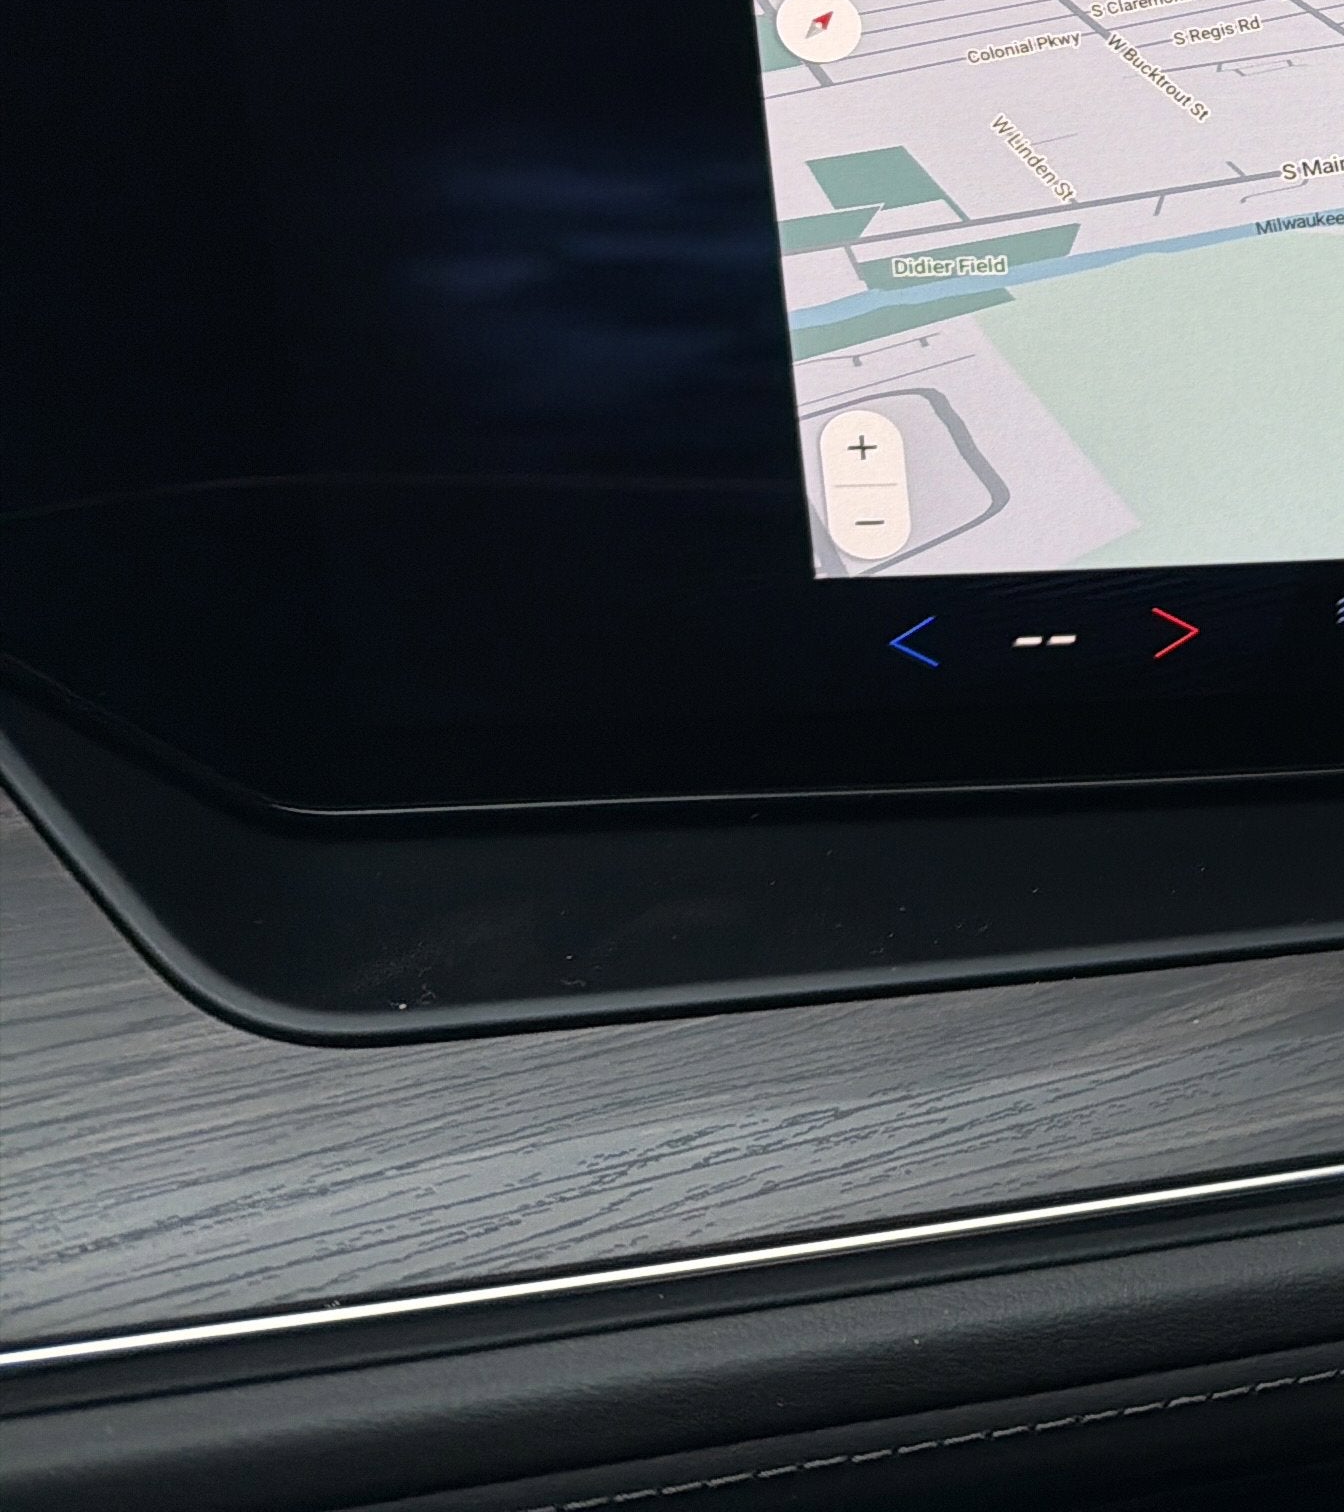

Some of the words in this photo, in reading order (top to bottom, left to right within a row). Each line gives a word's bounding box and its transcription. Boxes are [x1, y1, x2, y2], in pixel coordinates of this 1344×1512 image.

[1091, 4, 1103, 17] S
[1173, 33, 1186, 46] S
[1190, 23, 1234, 45] Regis
[1239, 17, 1261, 32] Rd
[967, 43, 1033, 65] Colonial
[1038, 31, 1081, 50] Pkwy
[1109, 34, 1127, 54] W
[1123, 45, 1191, 109] Bucktrout
[1191, 102, 1210, 122] St
[992, 115, 1013, 137] W
[1009, 133, 1055, 184] Linden
[1055, 181, 1073, 202] St
[1281, 164, 1297, 180] S
[894, 257, 953, 276] Didier
[958, 256, 1007, 274] Field
